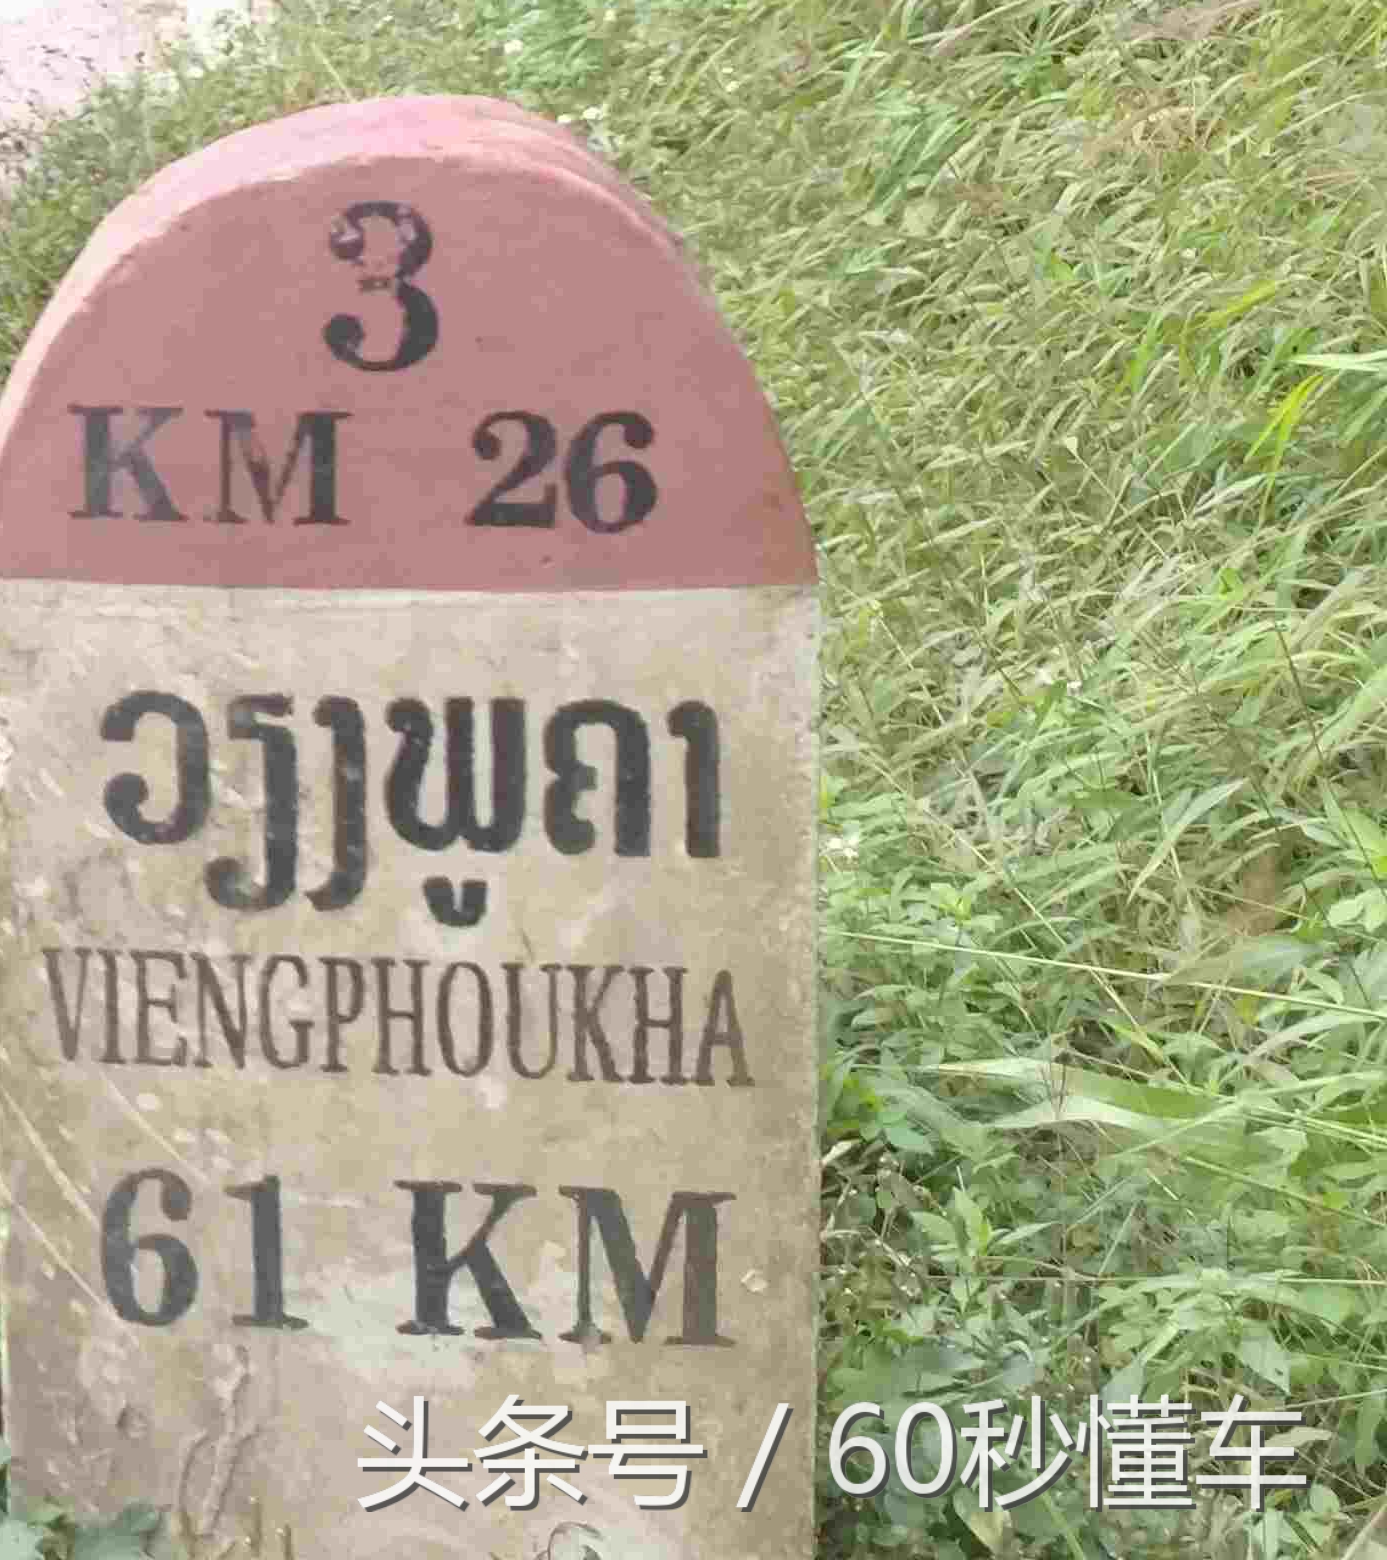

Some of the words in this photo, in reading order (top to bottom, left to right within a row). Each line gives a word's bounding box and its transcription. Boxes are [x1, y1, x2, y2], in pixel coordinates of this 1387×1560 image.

[321, 200, 441, 372] 3
[68, 404, 353, 526] KM
[465, 410, 659, 534] 26
[42, 946, 756, 1088] VIENGPHOUKHA
[100, 1166, 309, 1330] 61
[395, 1178, 739, 1348] KM
